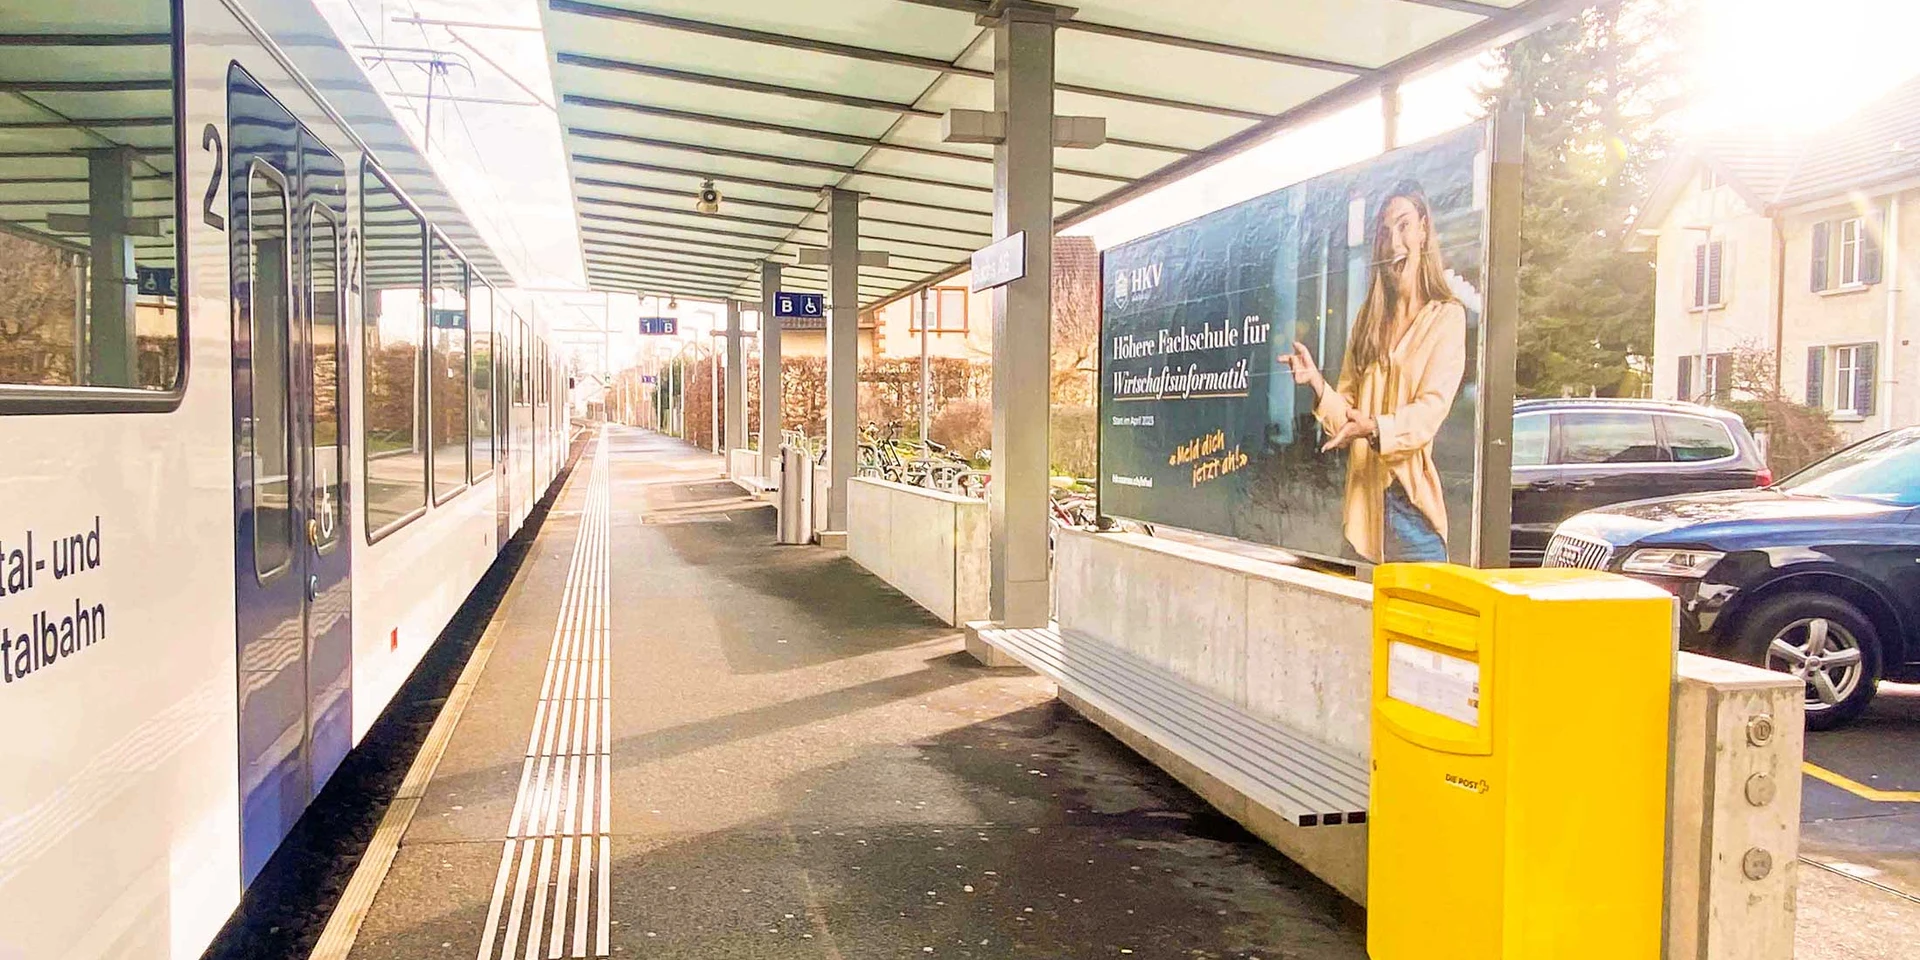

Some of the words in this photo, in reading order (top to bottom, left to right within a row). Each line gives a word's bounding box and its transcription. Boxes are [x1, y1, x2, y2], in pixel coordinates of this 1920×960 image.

[203, 123, 224, 231] 2
[350, 228, 360, 294] 2
[1131, 261, 1164, 292] HKV
[781, 300, 793, 313] B
[664, 322, 674, 334] B
[1113, 334, 1155, 360] Höhere
[1158, 319, 1239, 355] Fachschule
[1242, 315, 1271, 345] für
[1112, 358, 1249, 400] Wirtschaftsinformatik
[1201, 428, 1225, 456] dich
[1192, 458, 1220, 488] jetzt
[53, 516, 100, 579] und
[0, 598, 105, 683] talbahn
[1445, 773, 1457, 784] DIE
[1458, 777, 1478, 790] POST
